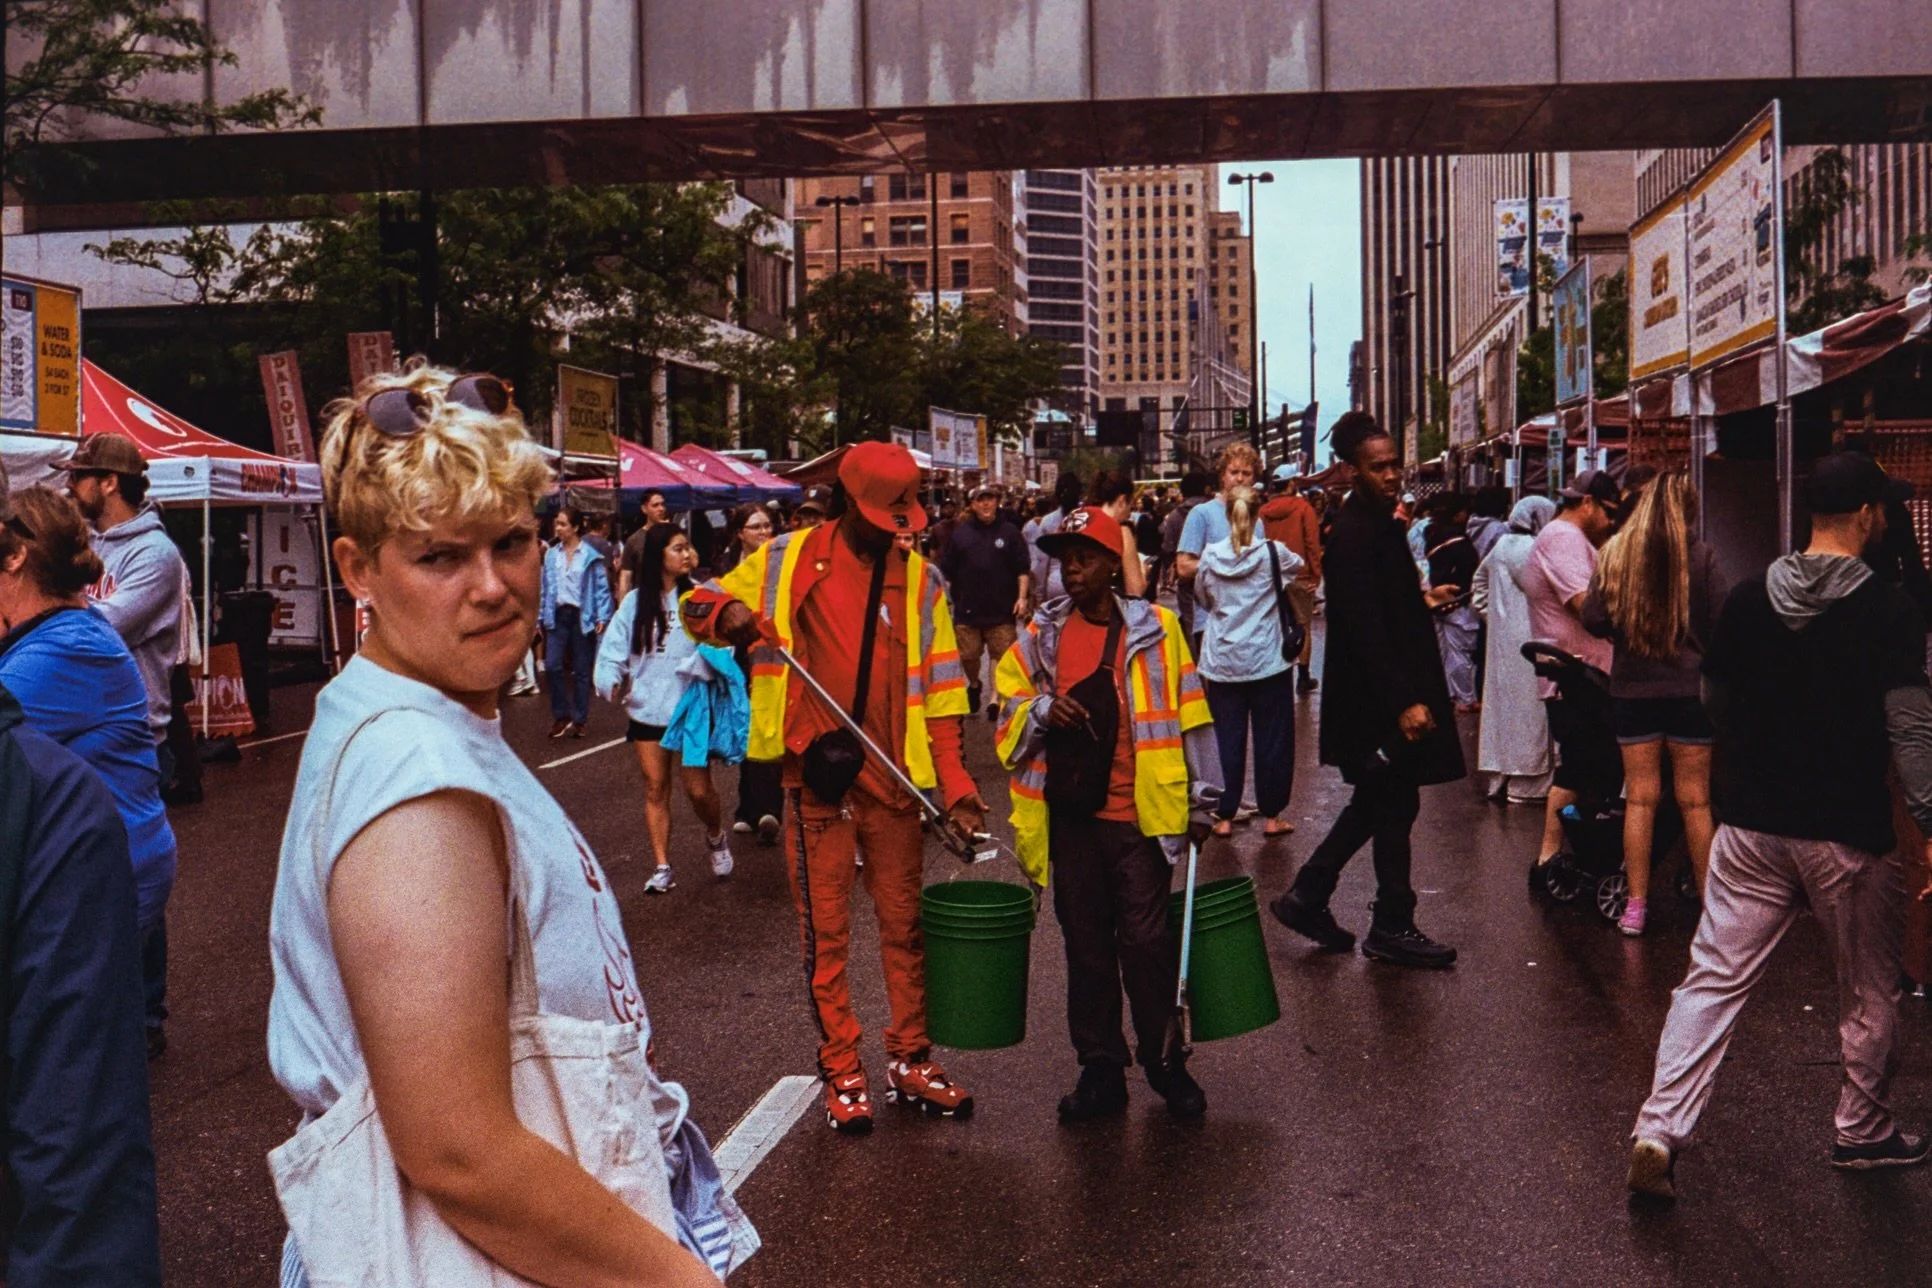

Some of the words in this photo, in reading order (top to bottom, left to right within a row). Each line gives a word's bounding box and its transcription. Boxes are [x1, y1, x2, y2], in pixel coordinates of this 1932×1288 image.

[41, 341, 48, 356] &
[50, 343, 72, 359] SODA
[43, 324, 70, 341] WATER
[274, 356, 302, 460] DAIQUIR
[271, 525, 297, 630] ICE
